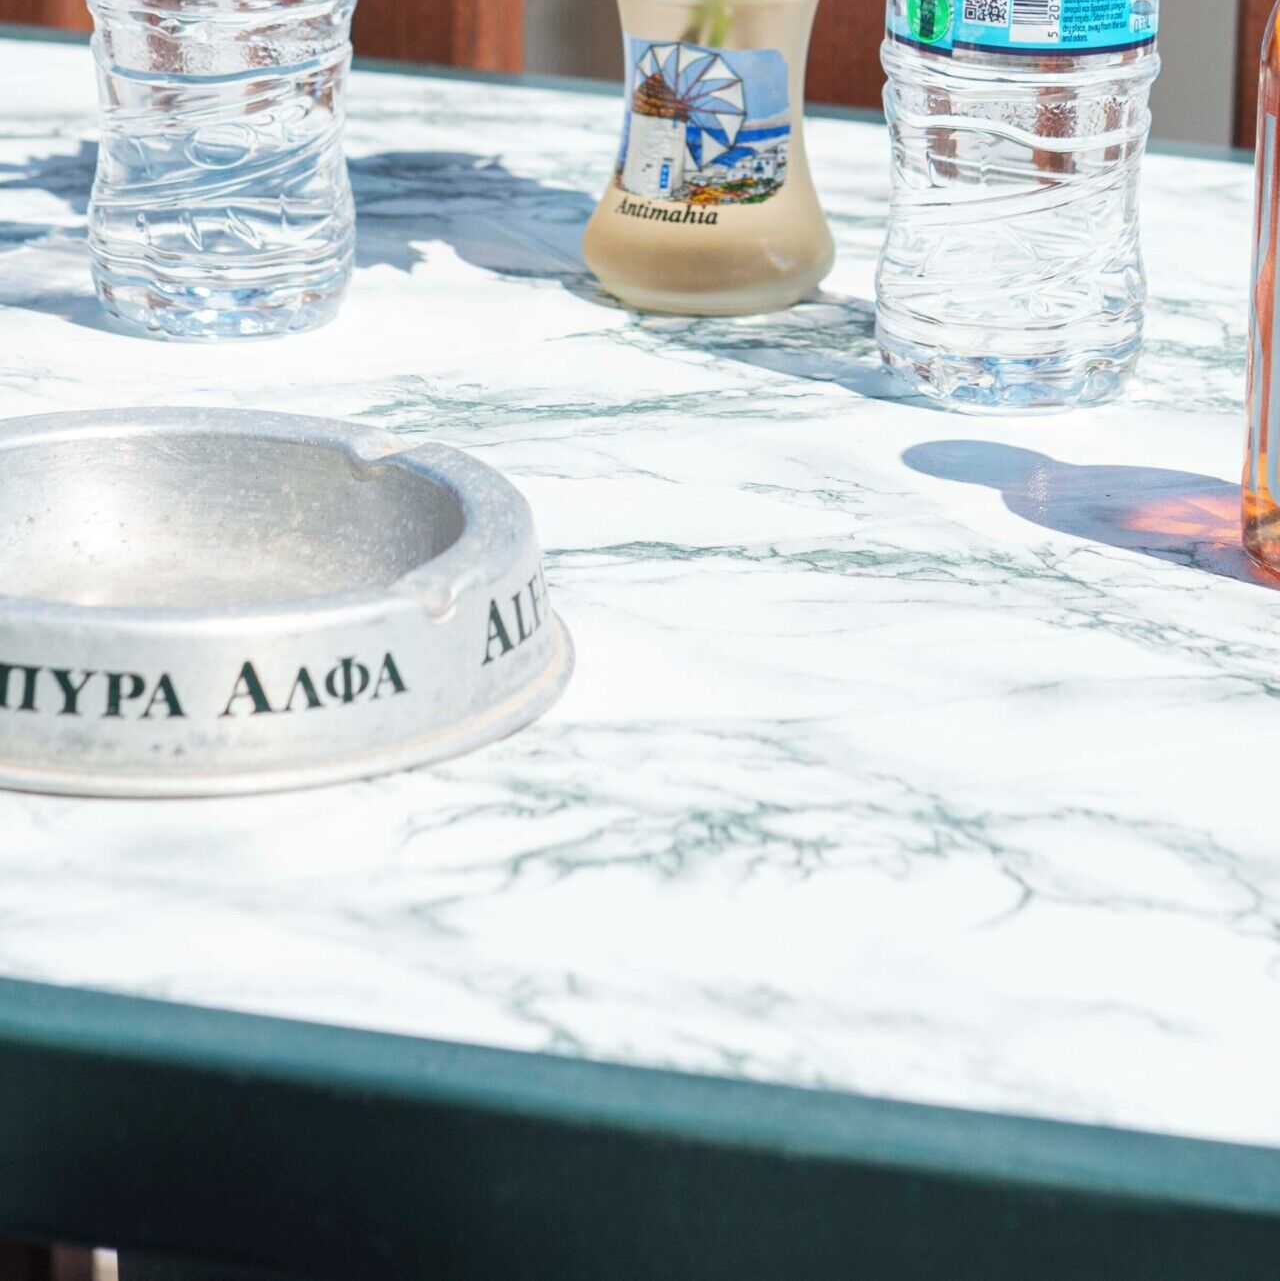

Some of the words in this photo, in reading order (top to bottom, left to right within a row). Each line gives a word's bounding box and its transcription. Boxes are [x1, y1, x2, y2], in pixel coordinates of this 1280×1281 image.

[615, 198, 718, 225] Antimahia
[482, 562, 548, 666] ALF
[219, 650, 408, 719] ΑΛΦΑ
